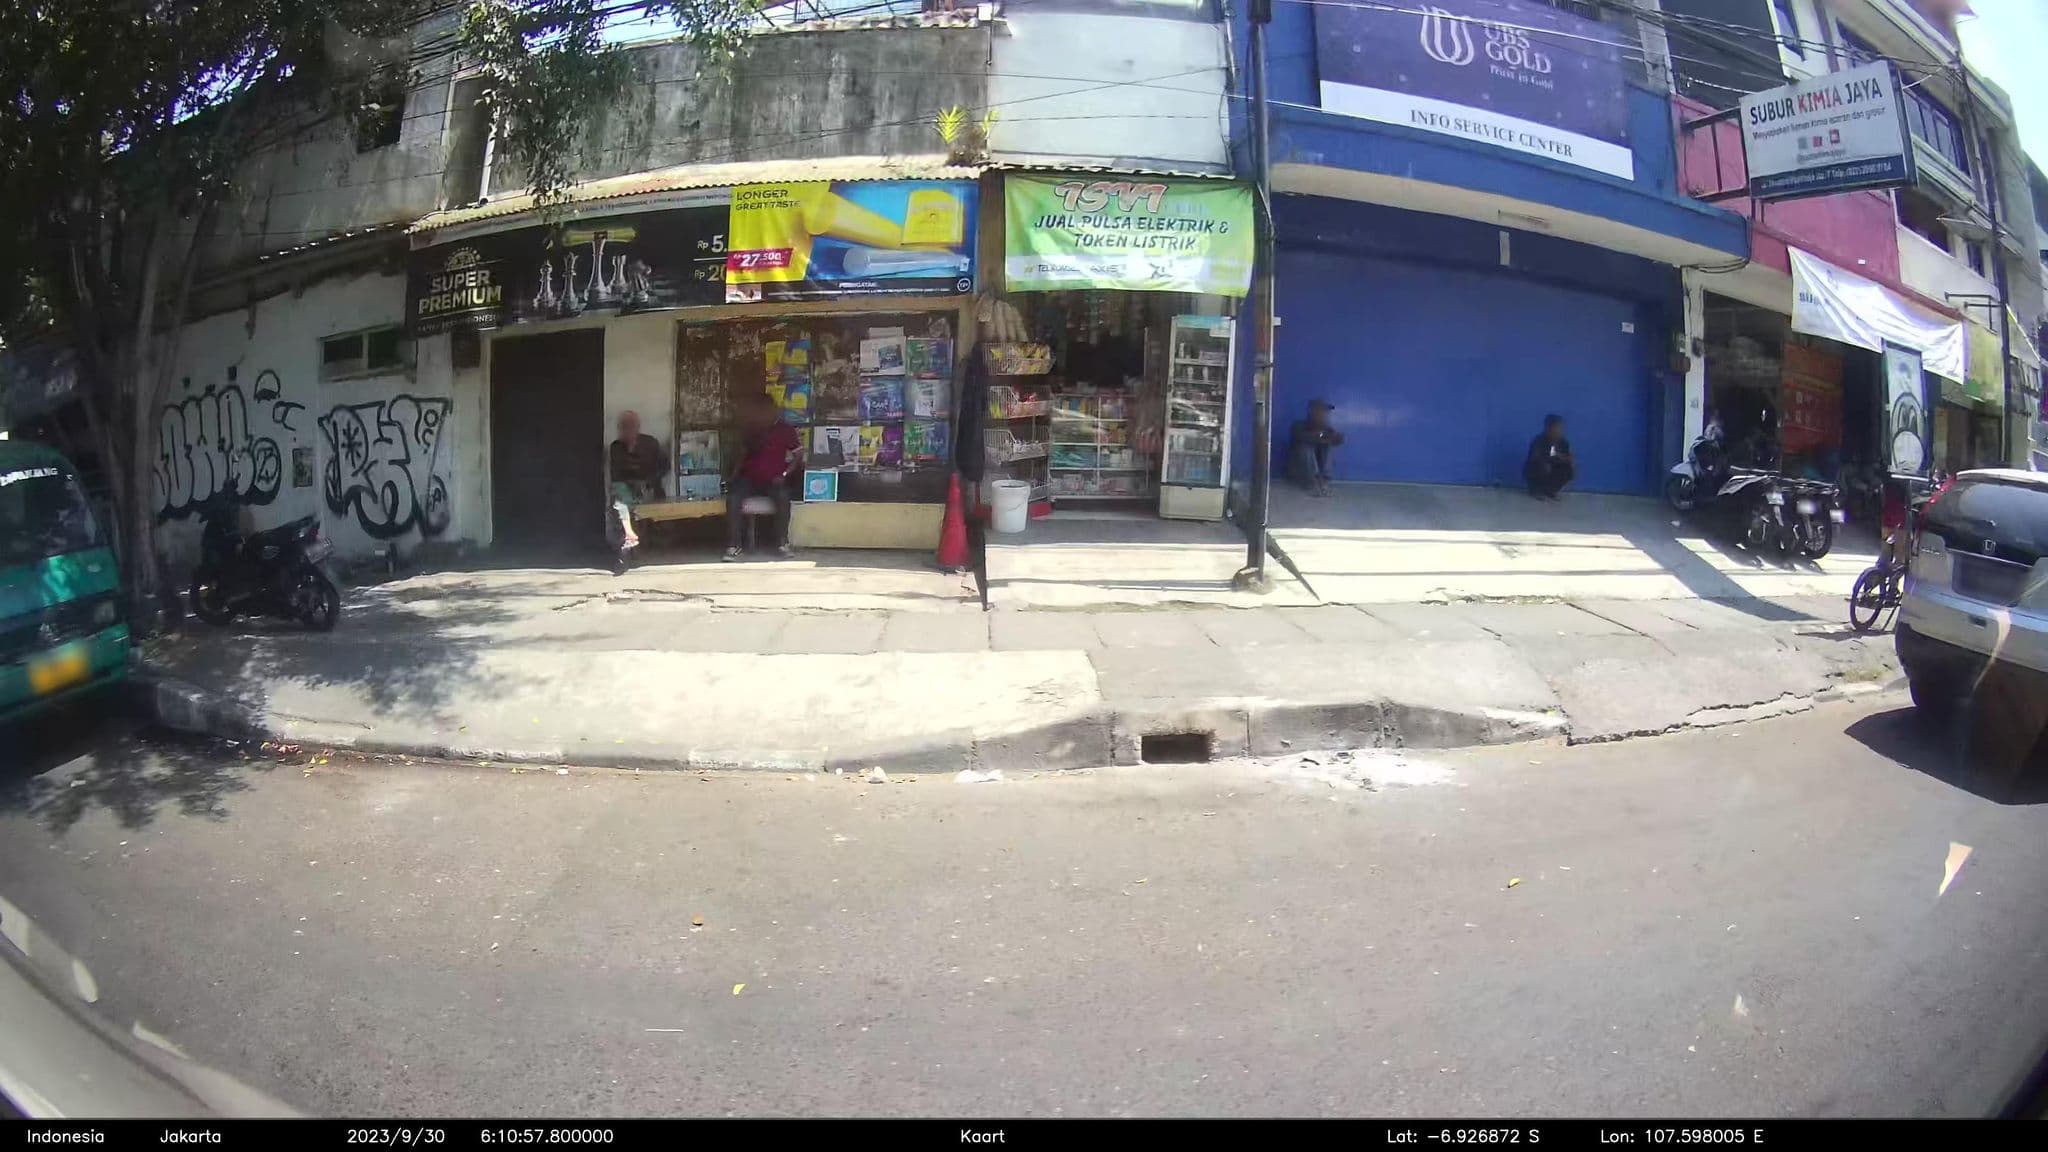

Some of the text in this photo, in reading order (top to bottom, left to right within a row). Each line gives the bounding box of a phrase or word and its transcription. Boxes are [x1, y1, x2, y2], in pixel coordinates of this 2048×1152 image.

[1485, 41, 1552, 73] GOLD
[1750, 77, 1883, 125] SUBUR KIMIA JAYA
[1411, 109, 1573, 157] INFO SERVICE CENTER
[736, 189, 788, 201] LONGER
[736, 202, 770, 211] GREAT
[1034, 213, 1229, 234] JUAL PULSA ELEKTRIK &
[697, 240, 709, 250] Rp
[1074, 233, 1196, 251] TOKEN LISTRIK
[431, 269, 490, 293] SUPER
[694, 269, 706, 280] Rp
[418, 284, 502, 315] PREMIUM
